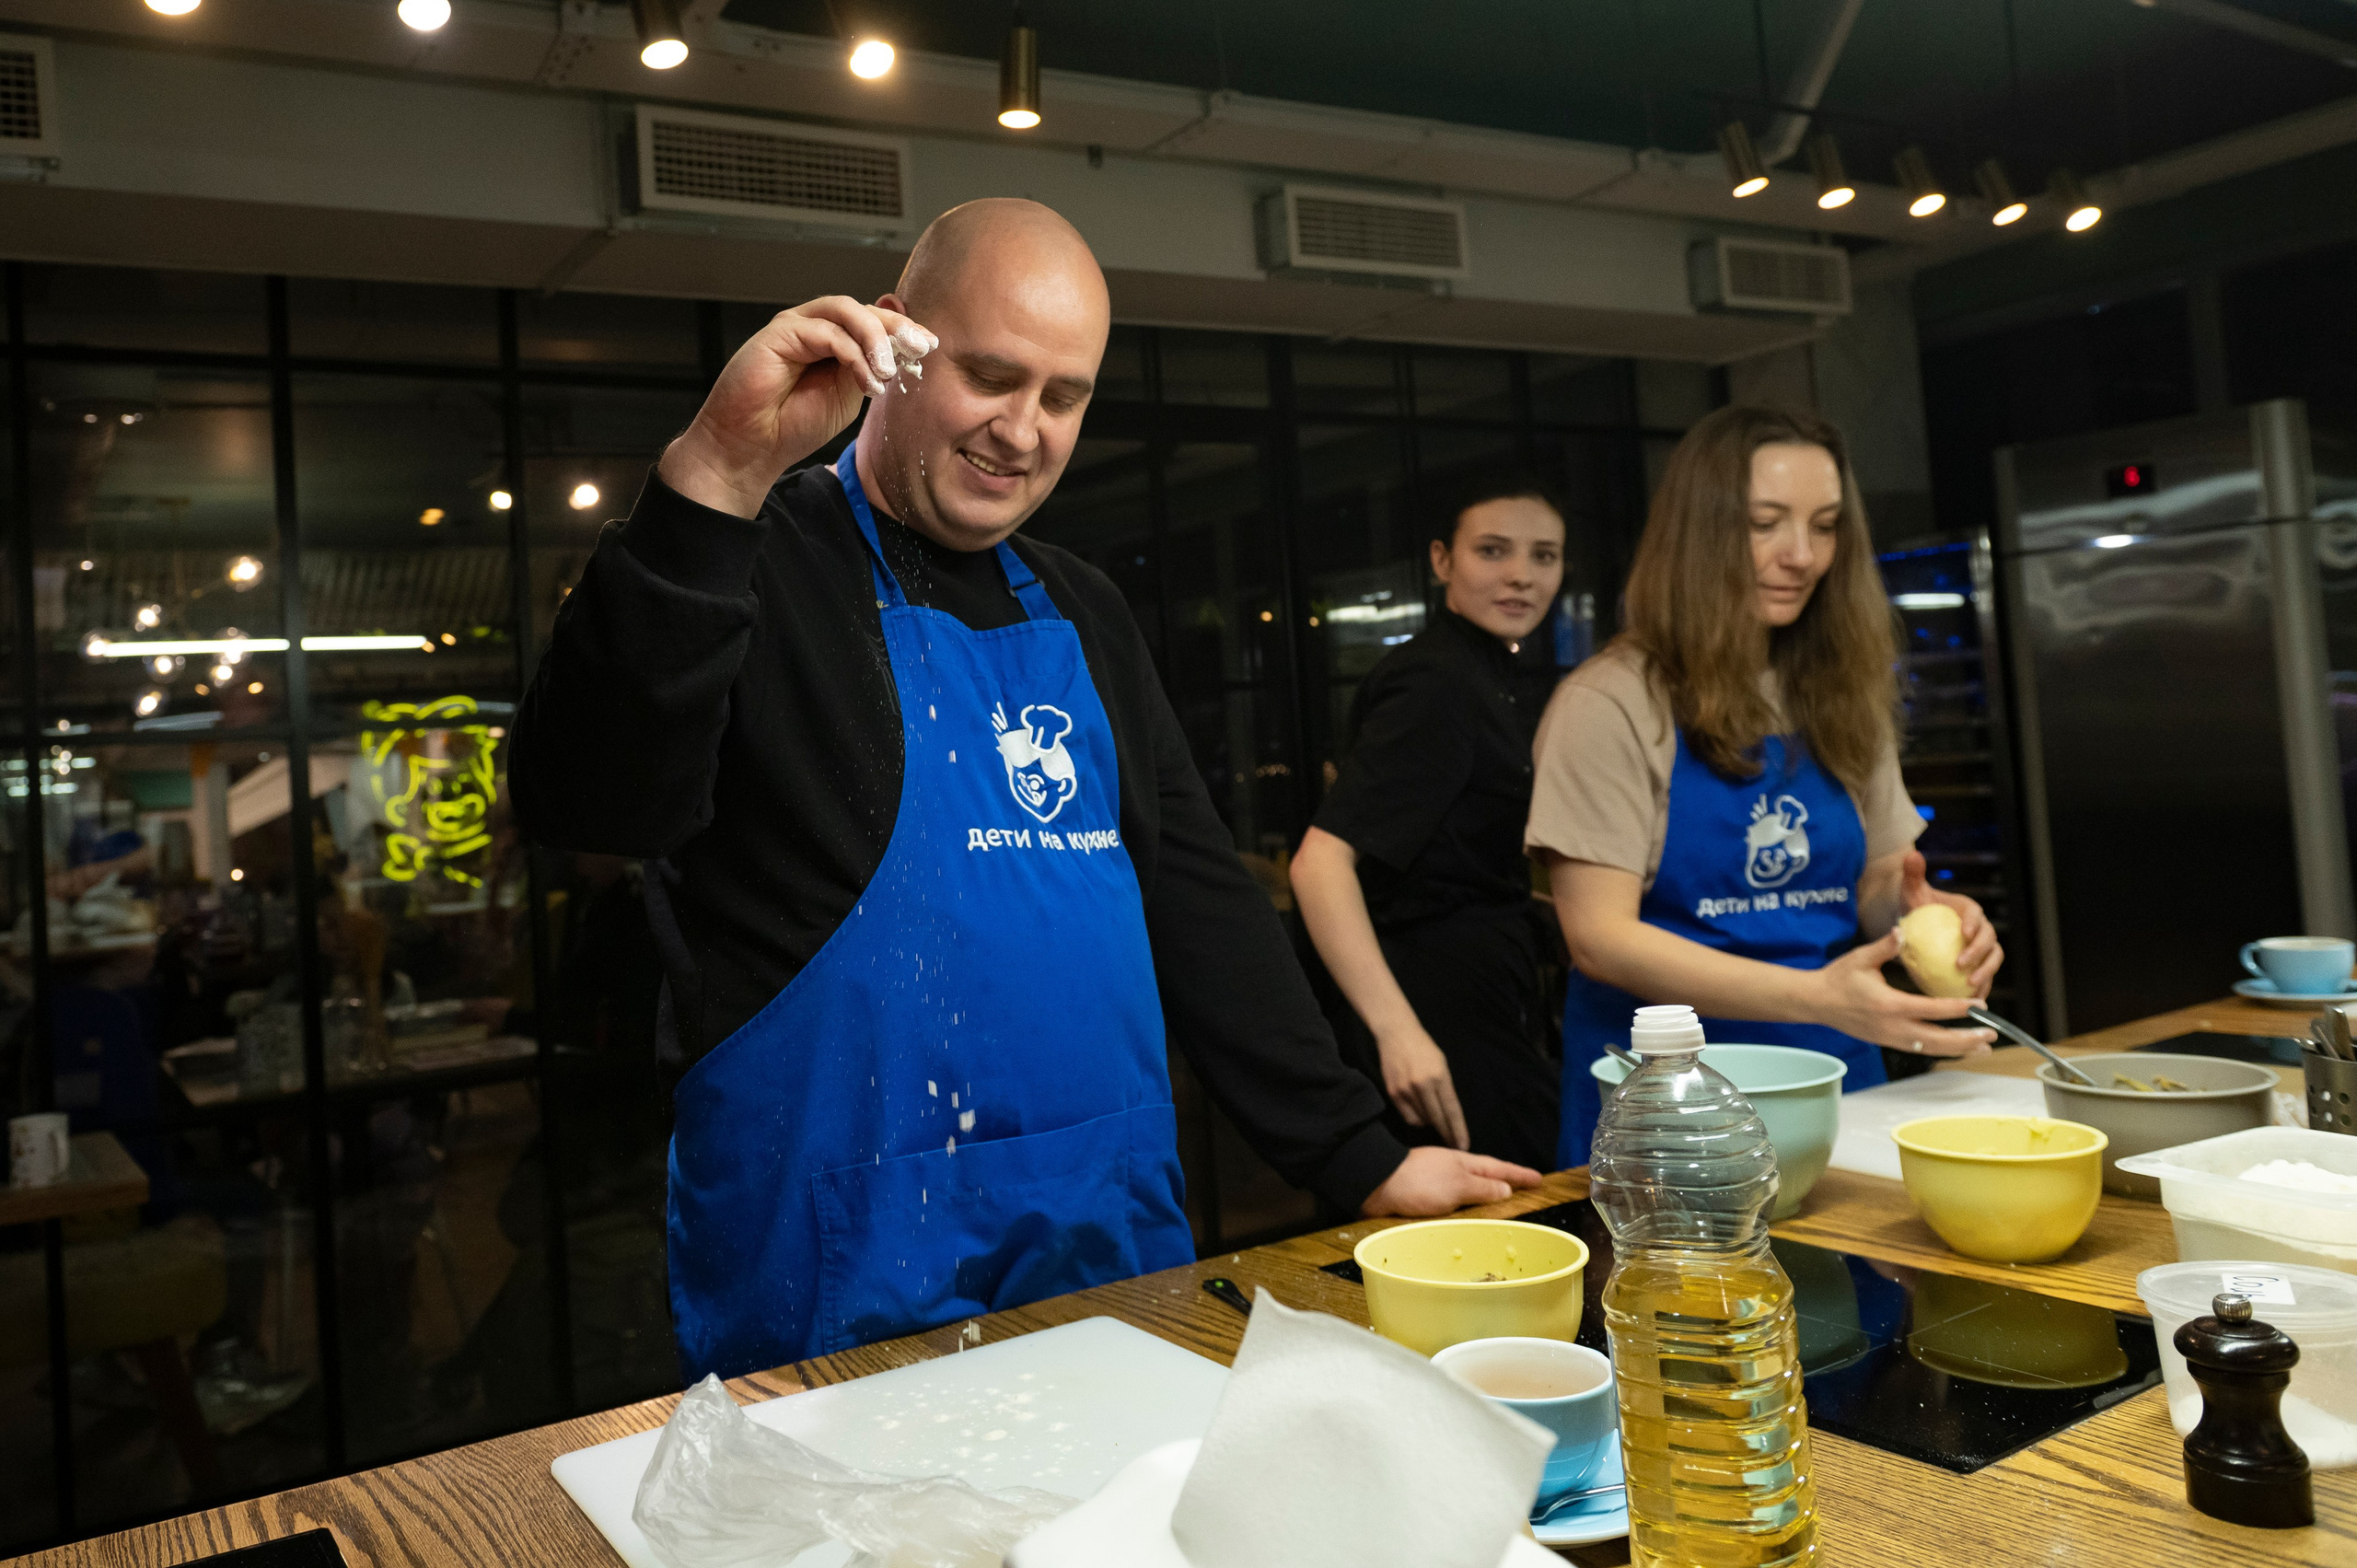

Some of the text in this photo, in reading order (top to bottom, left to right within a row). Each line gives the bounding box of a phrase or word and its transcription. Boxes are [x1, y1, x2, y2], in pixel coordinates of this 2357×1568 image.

[1038, 830, 1065, 851] на
[1066, 829, 1120, 855] кухне
[1752, 891, 1781, 912] на
